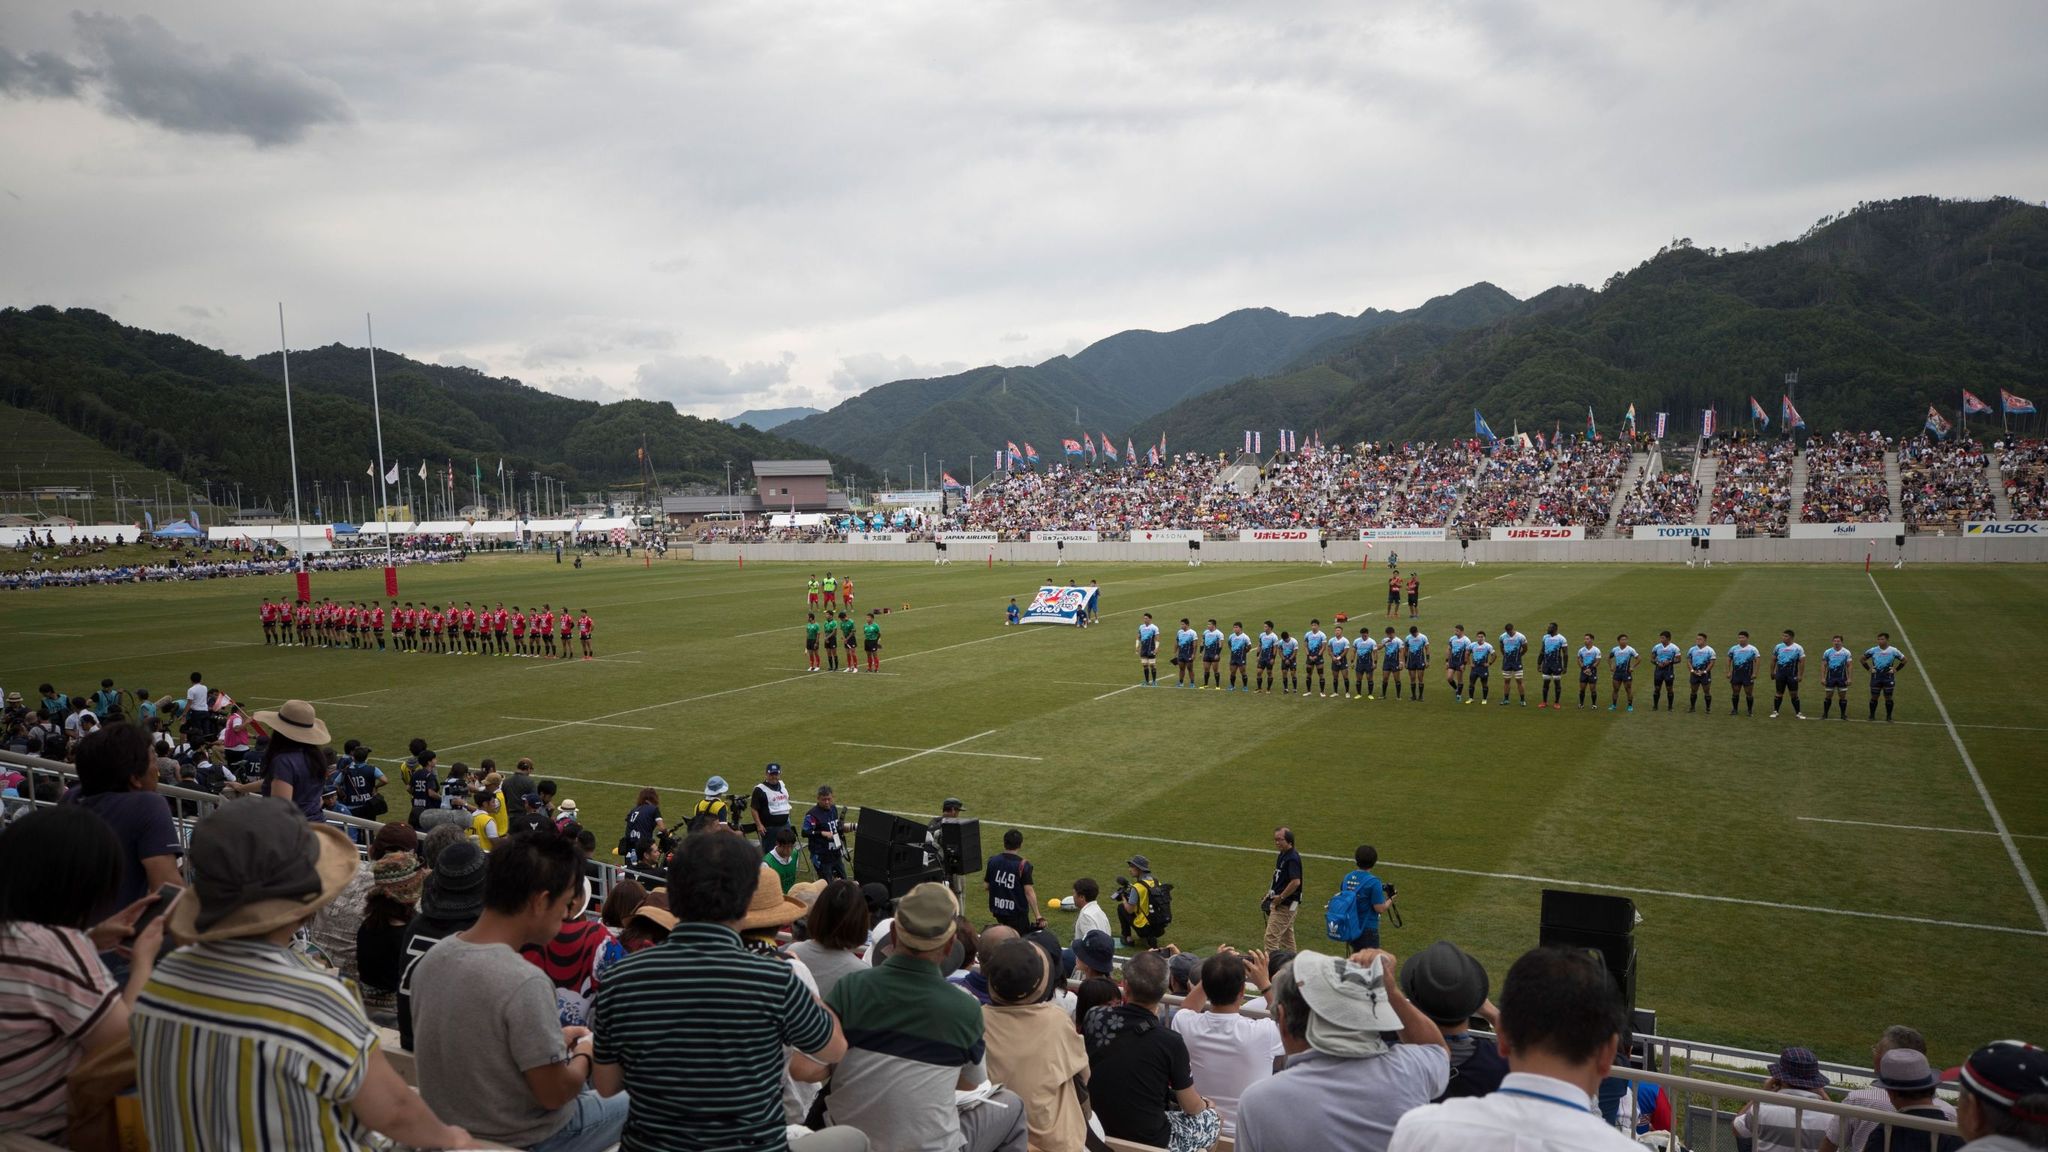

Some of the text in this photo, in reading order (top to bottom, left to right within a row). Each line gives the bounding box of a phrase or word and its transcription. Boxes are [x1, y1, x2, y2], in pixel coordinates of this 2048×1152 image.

[1657, 527, 1711, 537] TOPPAN
[1833, 525, 1856, 533] Asahi
[1983, 523, 2038, 534] ALSOK
[994, 870, 1016, 889] 449
